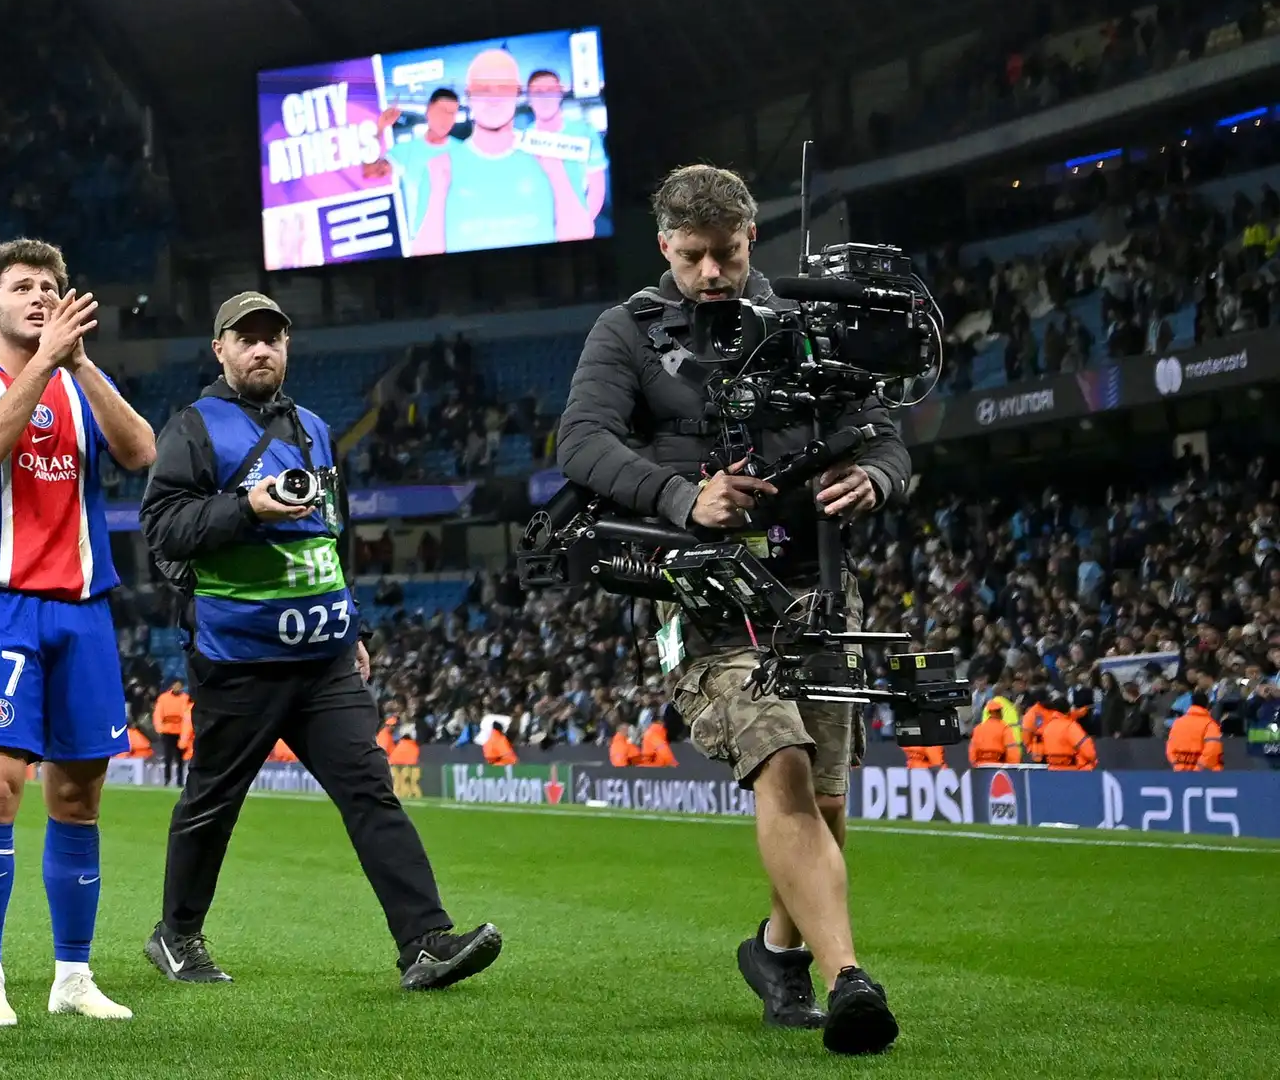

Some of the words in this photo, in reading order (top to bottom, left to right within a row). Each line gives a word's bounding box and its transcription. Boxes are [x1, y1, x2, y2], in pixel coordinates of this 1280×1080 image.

[281, 82, 348, 137] CITY
[268, 121, 382, 184] ATHENS
[1185, 349, 1248, 378] mastercard
[999, 389, 1054, 418] HYUNDAI
[18, 452, 76, 472] QATAR
[34, 470, 77, 482] AIRWAYS
[284, 545, 337, 588] HB
[278, 599, 351, 646] 023
[452, 763, 542, 803] Heineken
[595, 778, 632, 809] UEFA
[632, 779, 718, 815] CHAMPIONS
[861, 766, 975, 824] PEPSI
[1140, 787, 1240, 837] PS5
